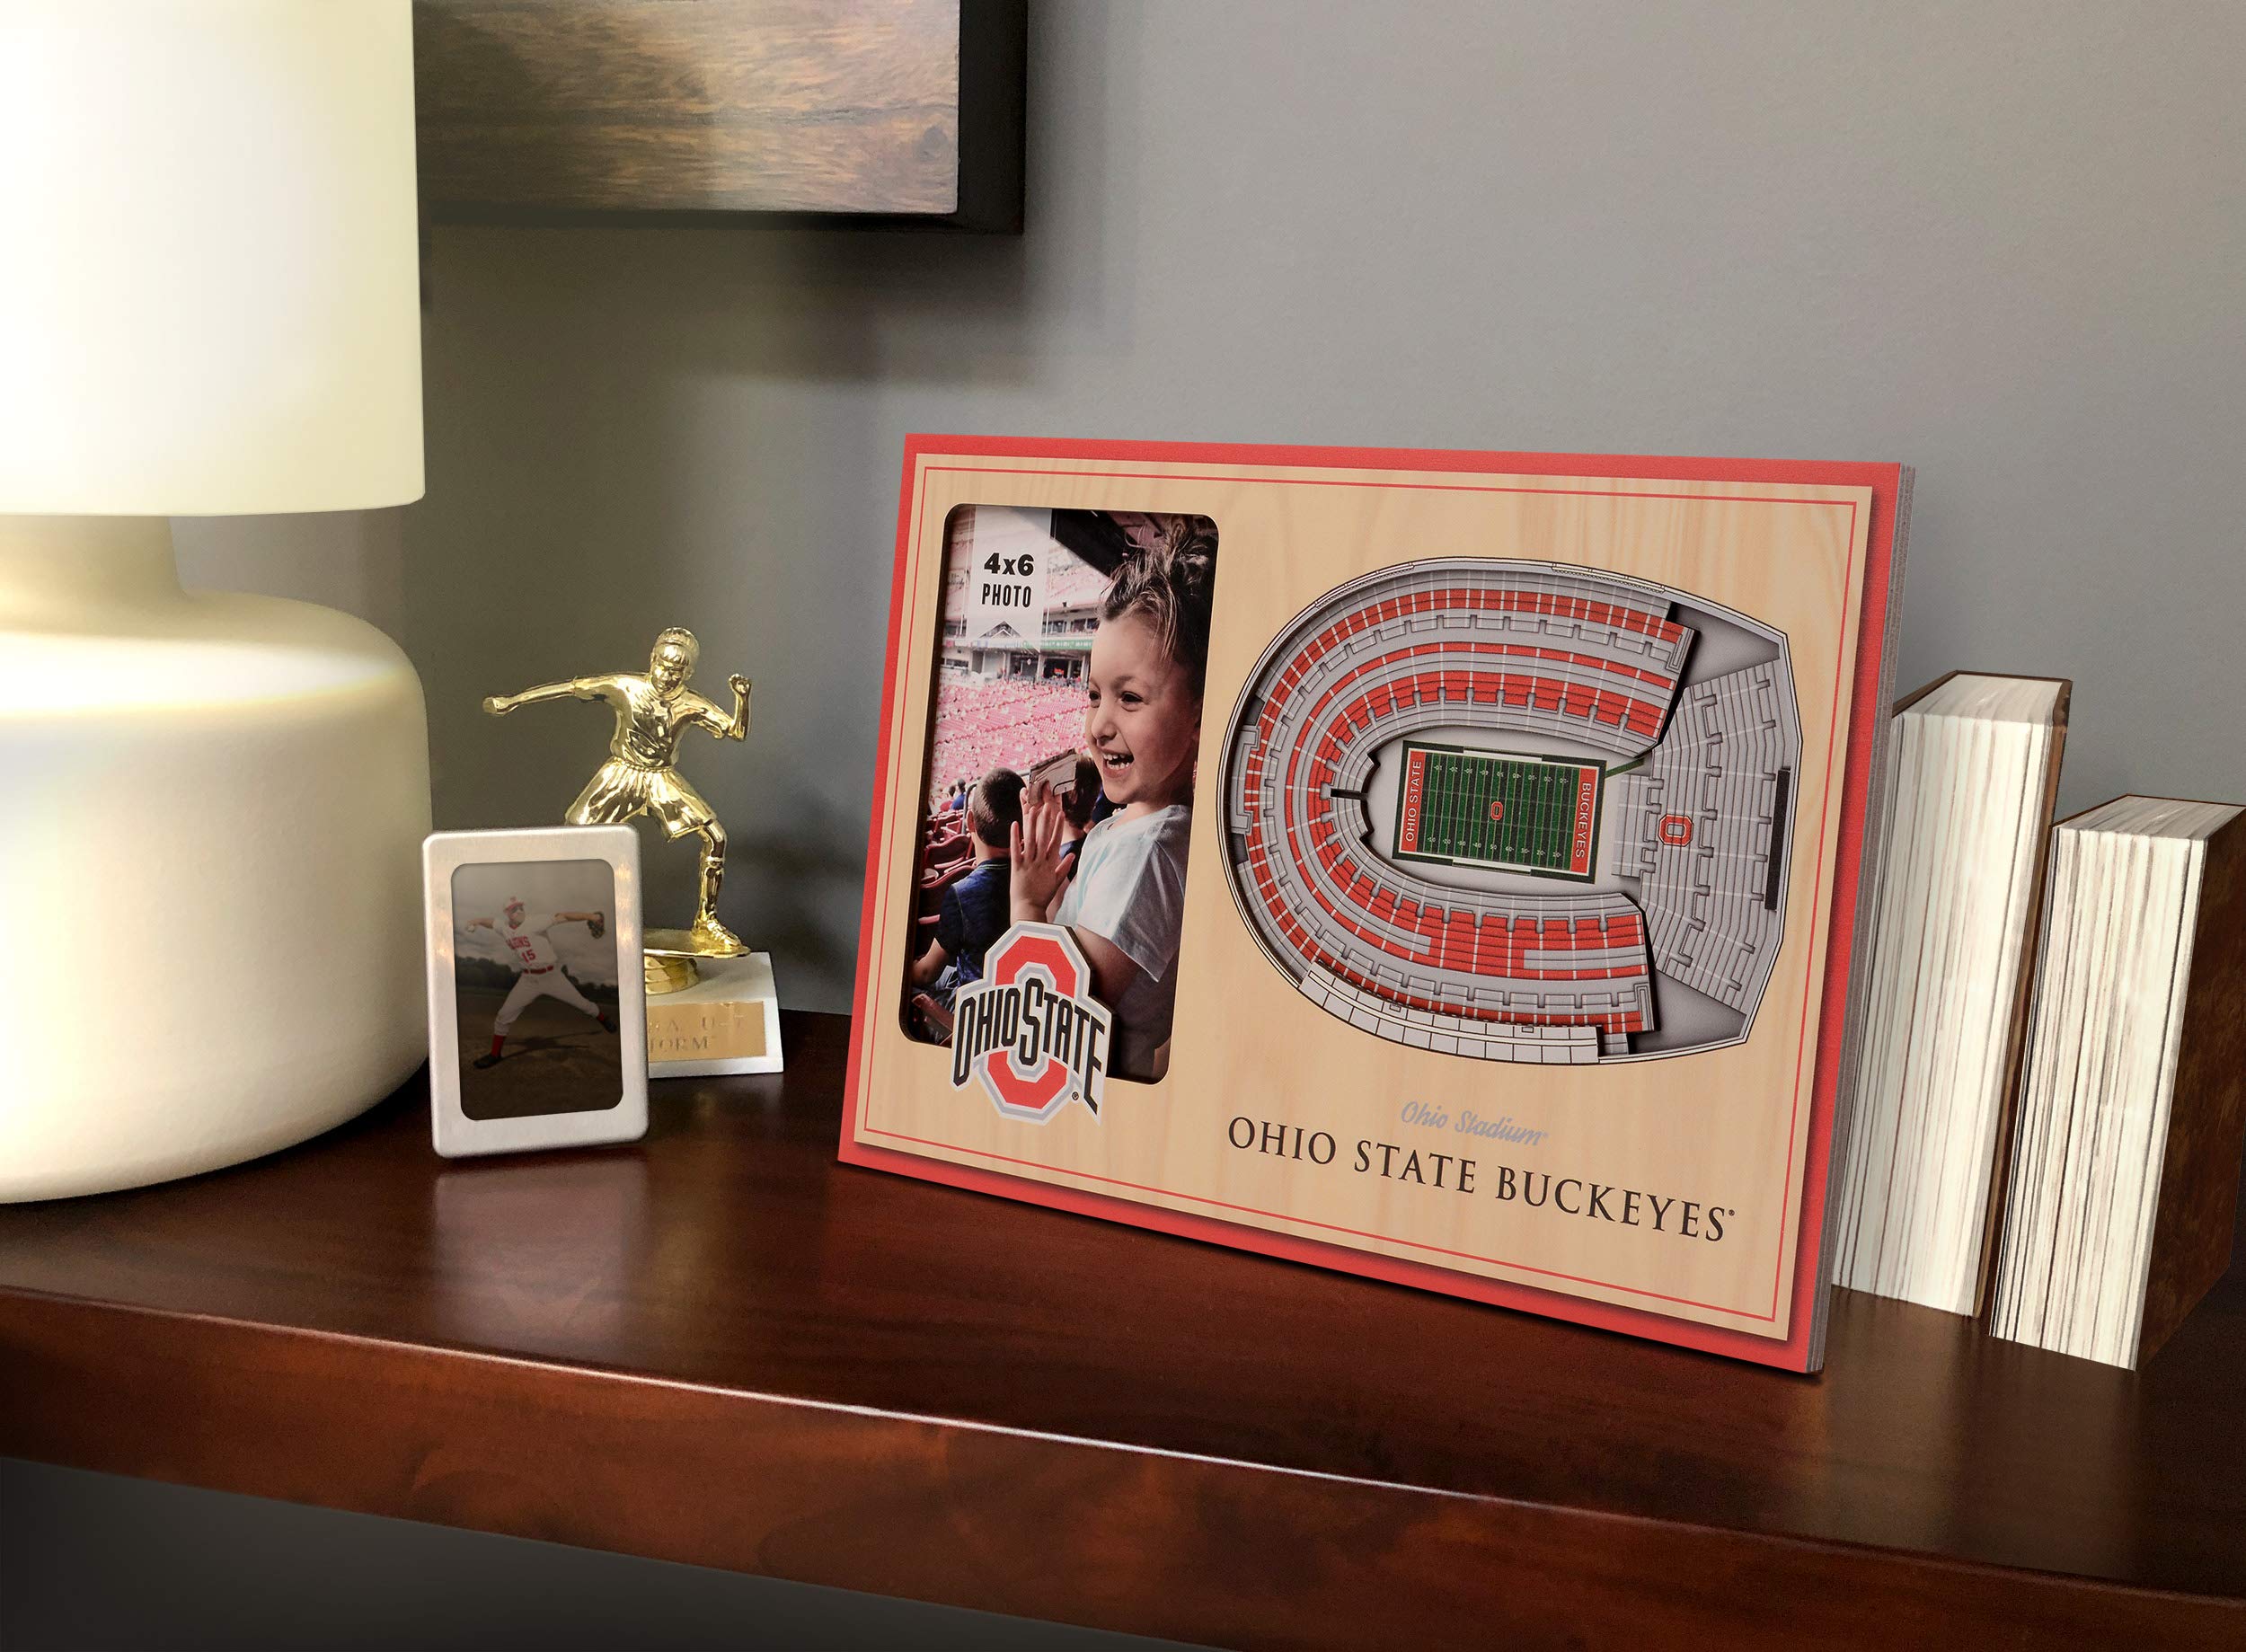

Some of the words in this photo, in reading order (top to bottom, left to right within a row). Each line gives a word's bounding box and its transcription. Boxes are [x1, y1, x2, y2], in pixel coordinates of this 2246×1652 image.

[984, 552, 1035, 577] 4x6
[981, 583, 1031, 608] PHOTO
[1410, 760, 1422, 804] STATE
[1405, 808, 1417, 843] OHIO
[1575, 782, 1592, 859] BUCKEYES
[521, 949, 536, 963] 15
[953, 987, 1021, 1087] OHIO
[1018, 977, 1106, 1115] STATE
[1400, 1100, 1449, 1129] Ohio
[1454, 1110, 1543, 1146] Stadium
[1227, 1116, 1337, 1165] OHIO
[1353, 1139, 1478, 1194] STATE
